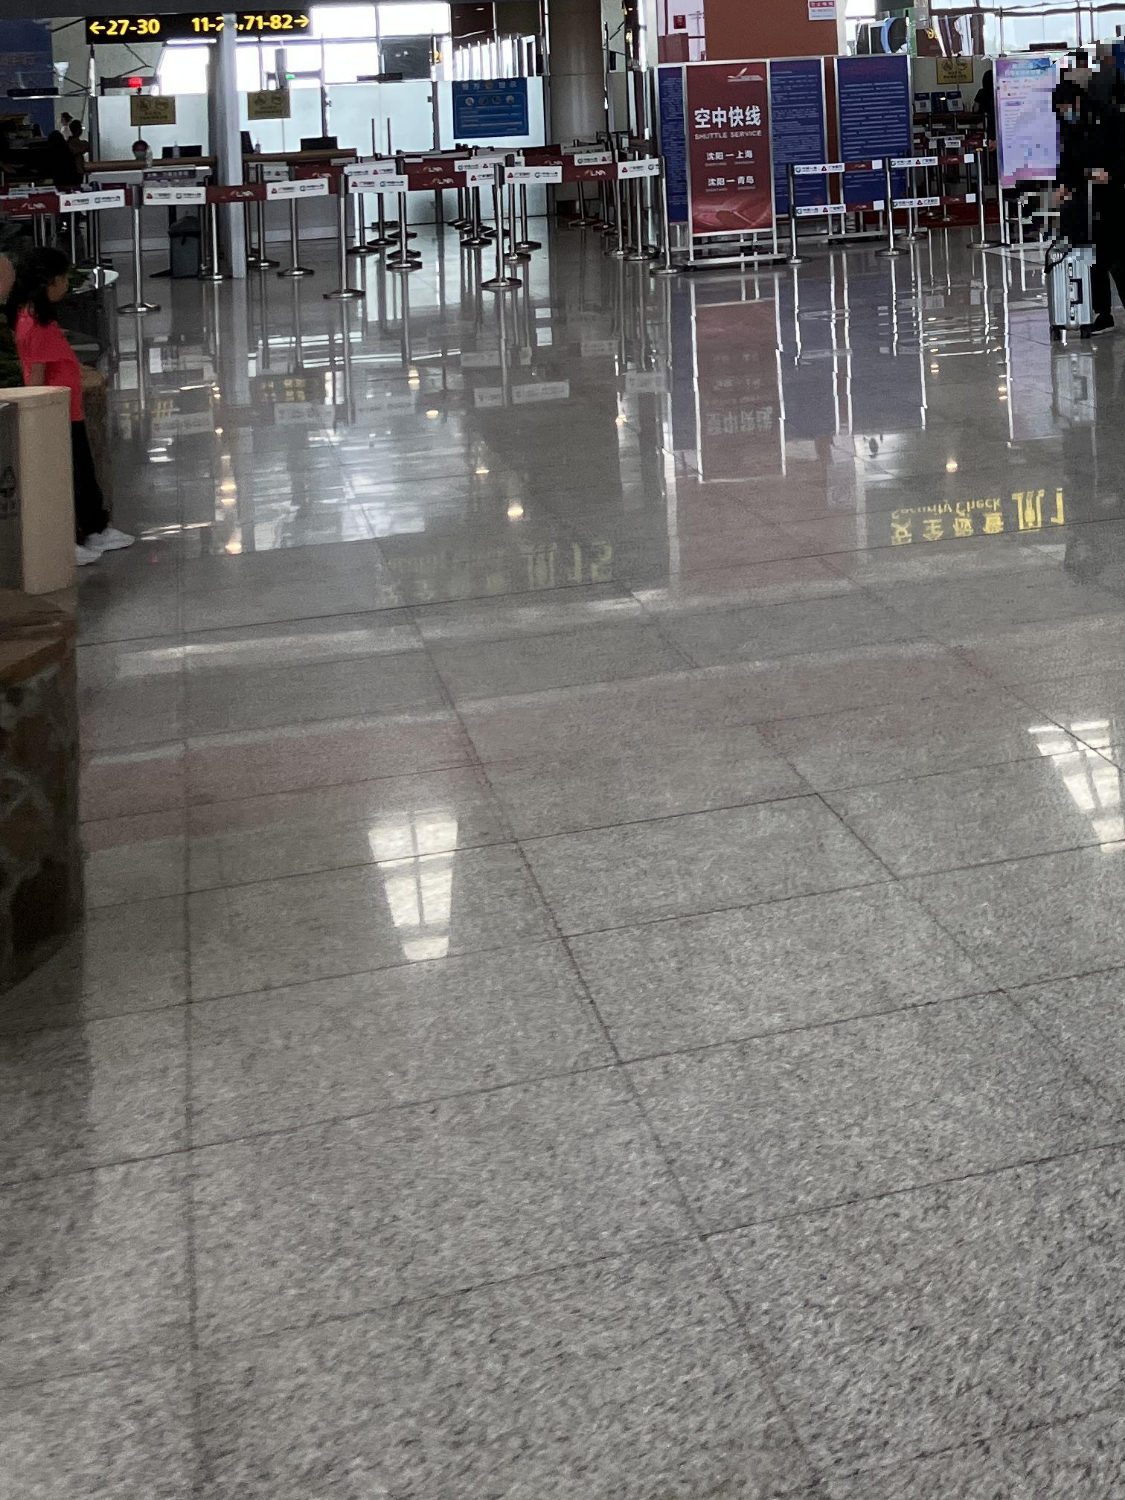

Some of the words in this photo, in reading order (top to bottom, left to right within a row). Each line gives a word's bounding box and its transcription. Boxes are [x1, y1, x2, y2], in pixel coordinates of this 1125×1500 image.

[106, 18, 161, 36] 27-30
[694, 105, 762, 129] 空中快线
[694, 132, 728, 140] SHUTTLE
[730, 129, 762, 138] SERVICE
